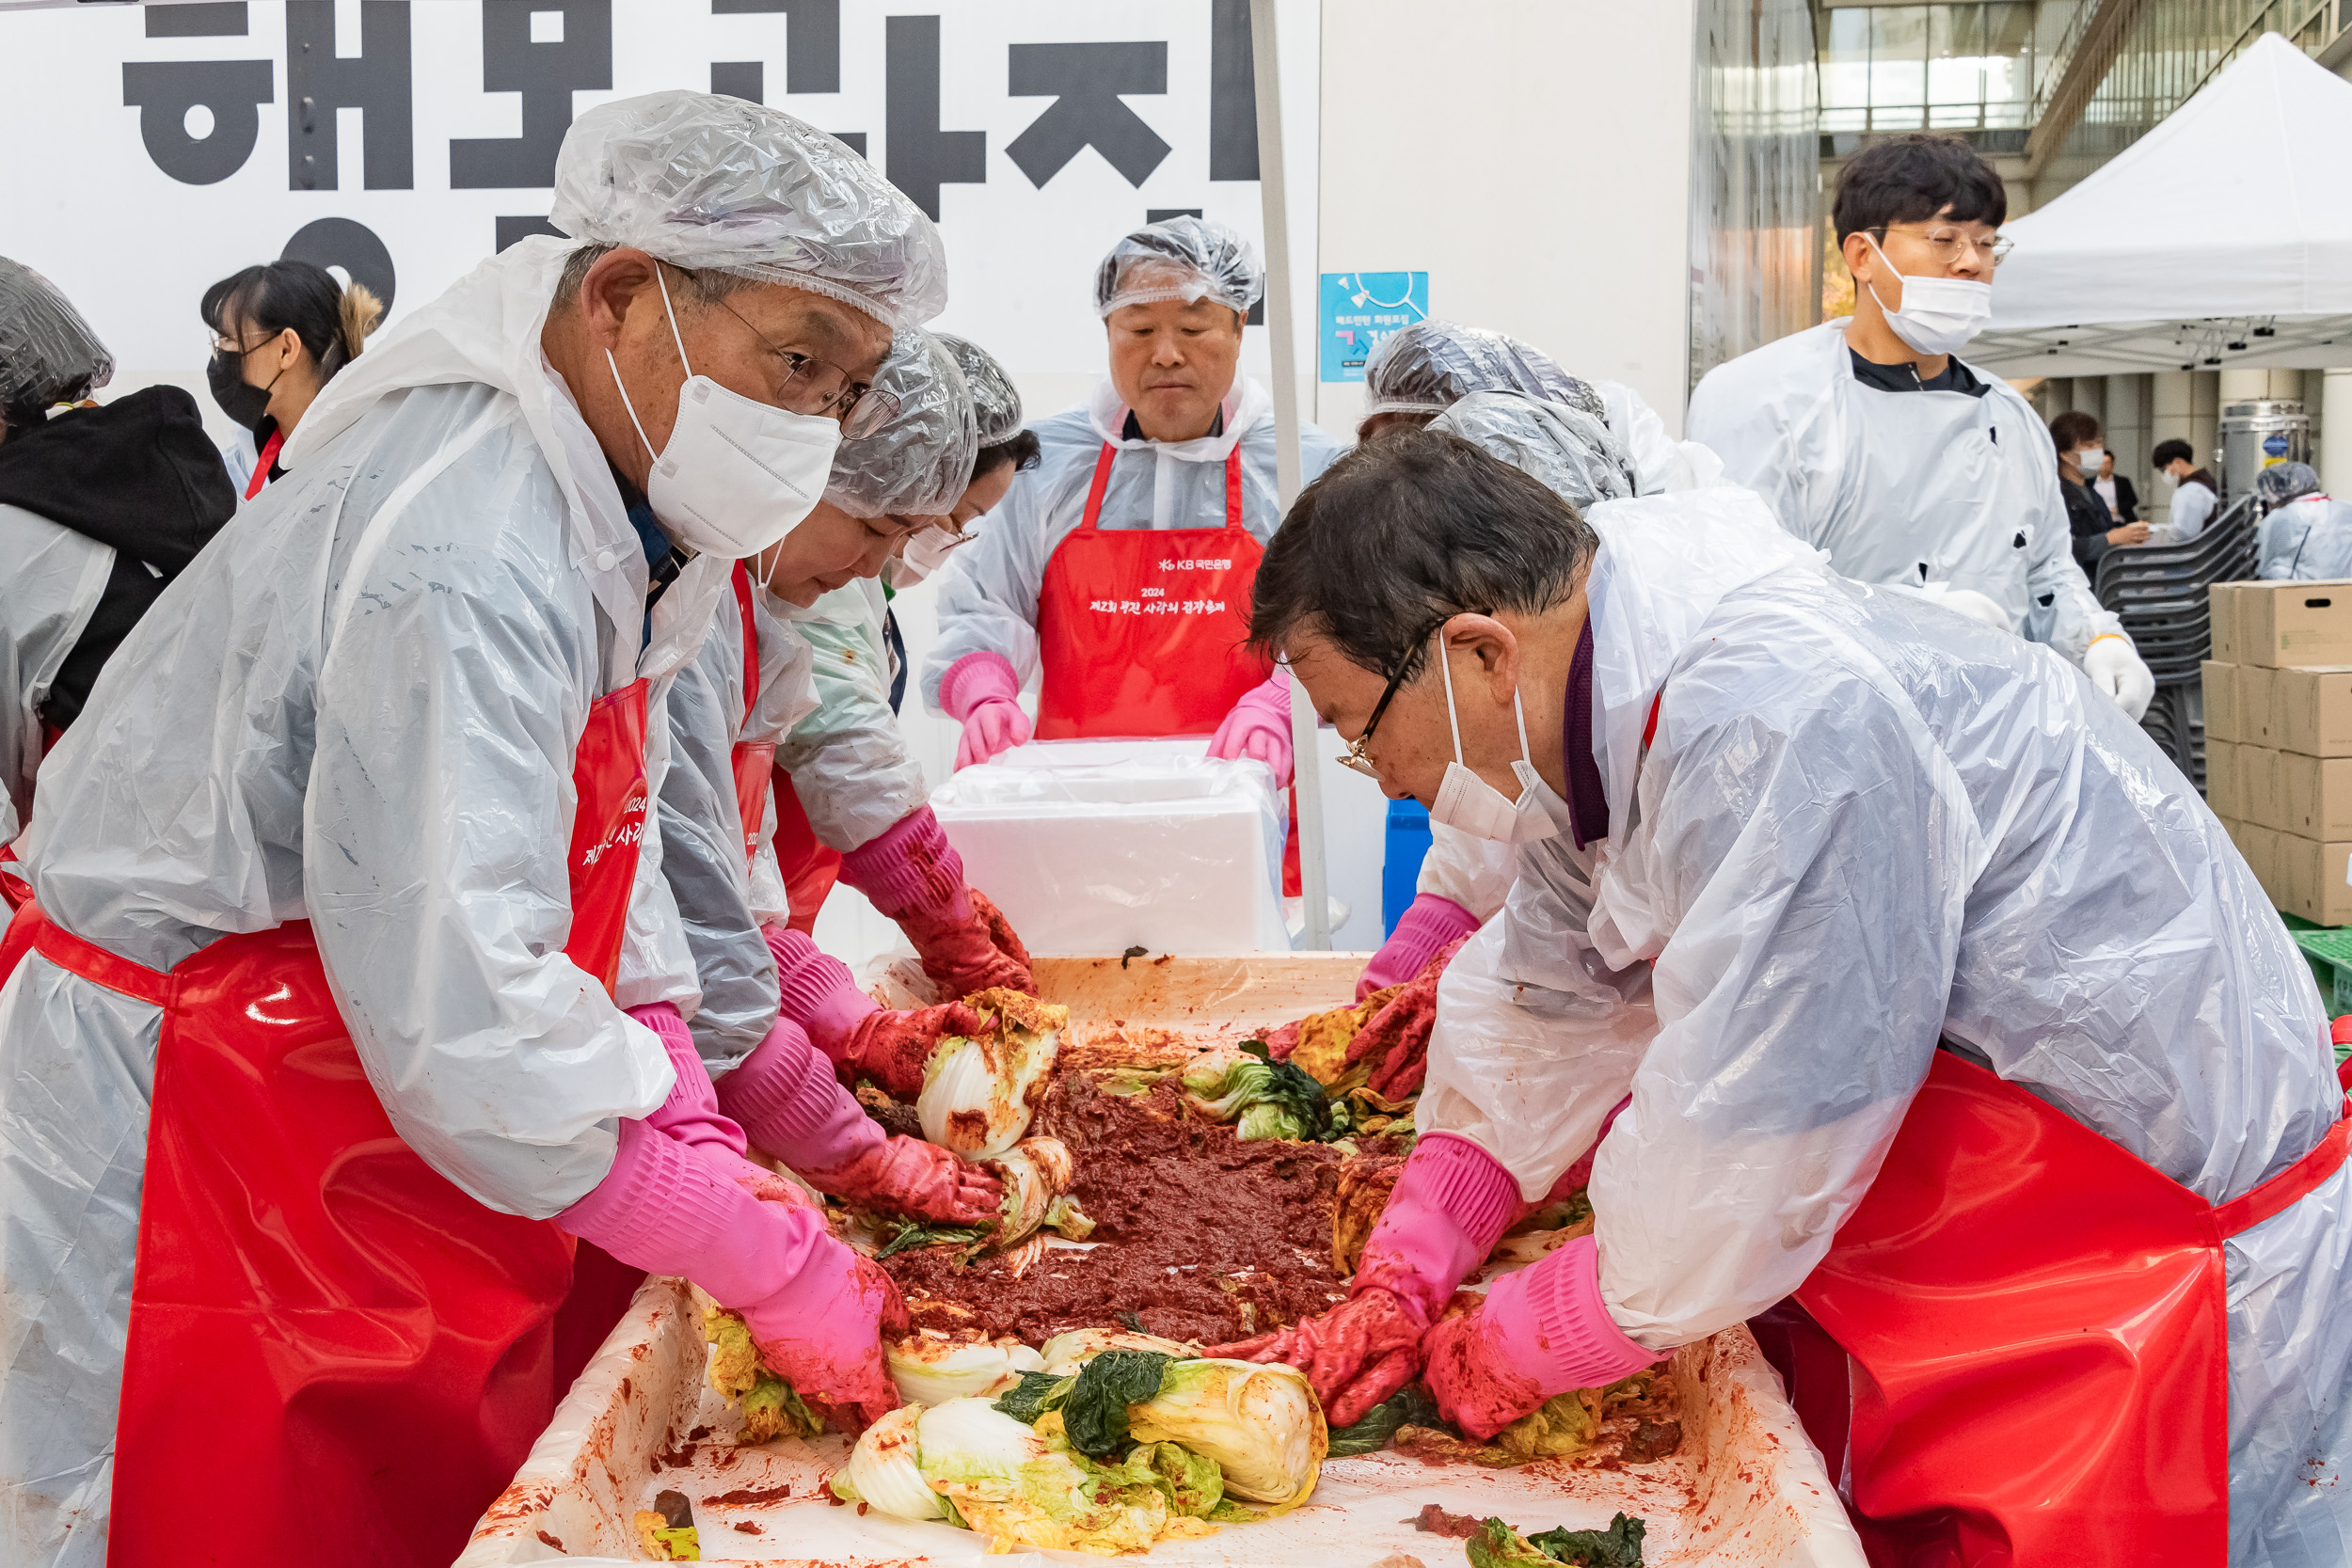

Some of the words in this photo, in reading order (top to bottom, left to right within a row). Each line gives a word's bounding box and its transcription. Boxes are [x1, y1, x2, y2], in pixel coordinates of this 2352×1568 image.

[1177, 560, 1194, 570] KB
[1195, 559, 1232, 570] 국민은행
[1141, 588, 1165, 597] 2024
[1089, 600, 1117, 613] 제2회
[1143, 601, 1179, 615] 사랑의
[1182, 599, 1225, 615] 김장축제
[623, 797, 647, 814] 2024
